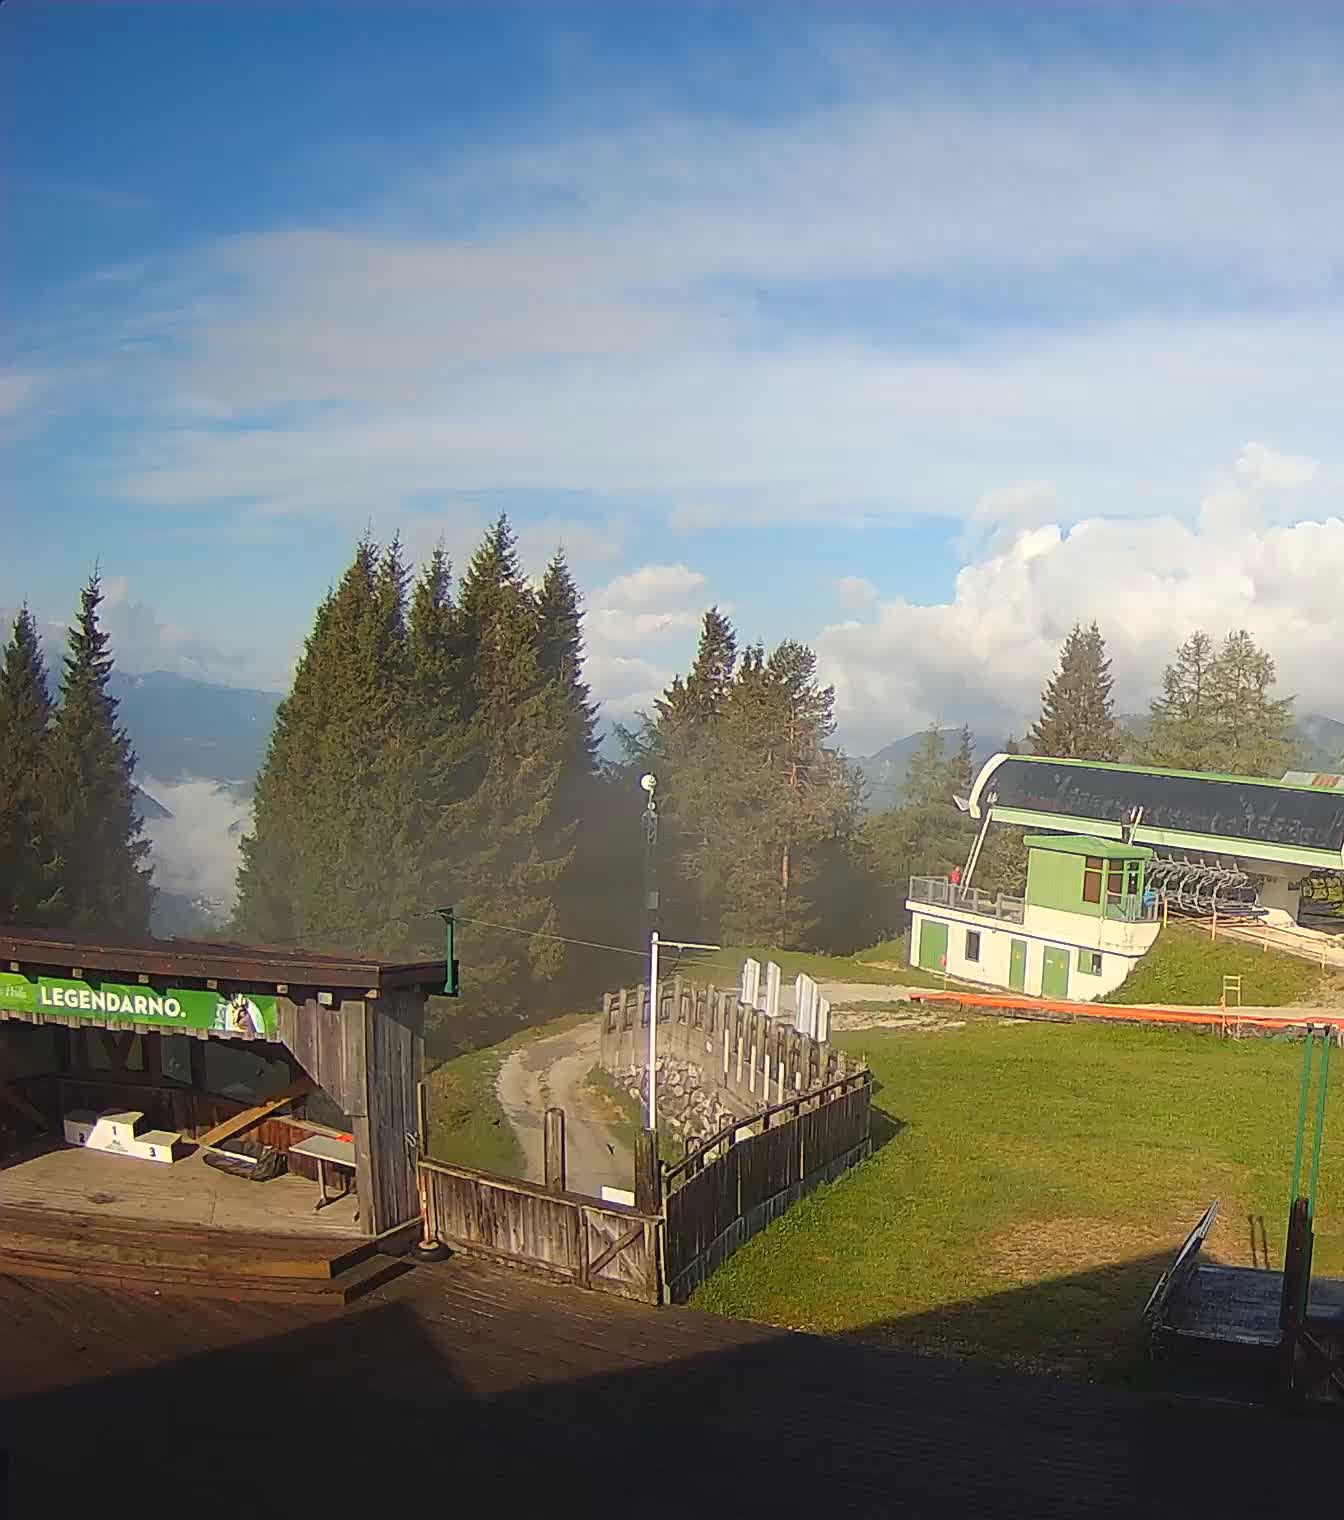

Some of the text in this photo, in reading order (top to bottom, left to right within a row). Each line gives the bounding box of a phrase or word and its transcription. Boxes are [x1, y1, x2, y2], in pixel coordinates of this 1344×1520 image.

[40, 986, 187, 1017] LEGENDARNO.
[79, 1133, 86, 1143] 2
[149, 1147, 157, 1157] 3
